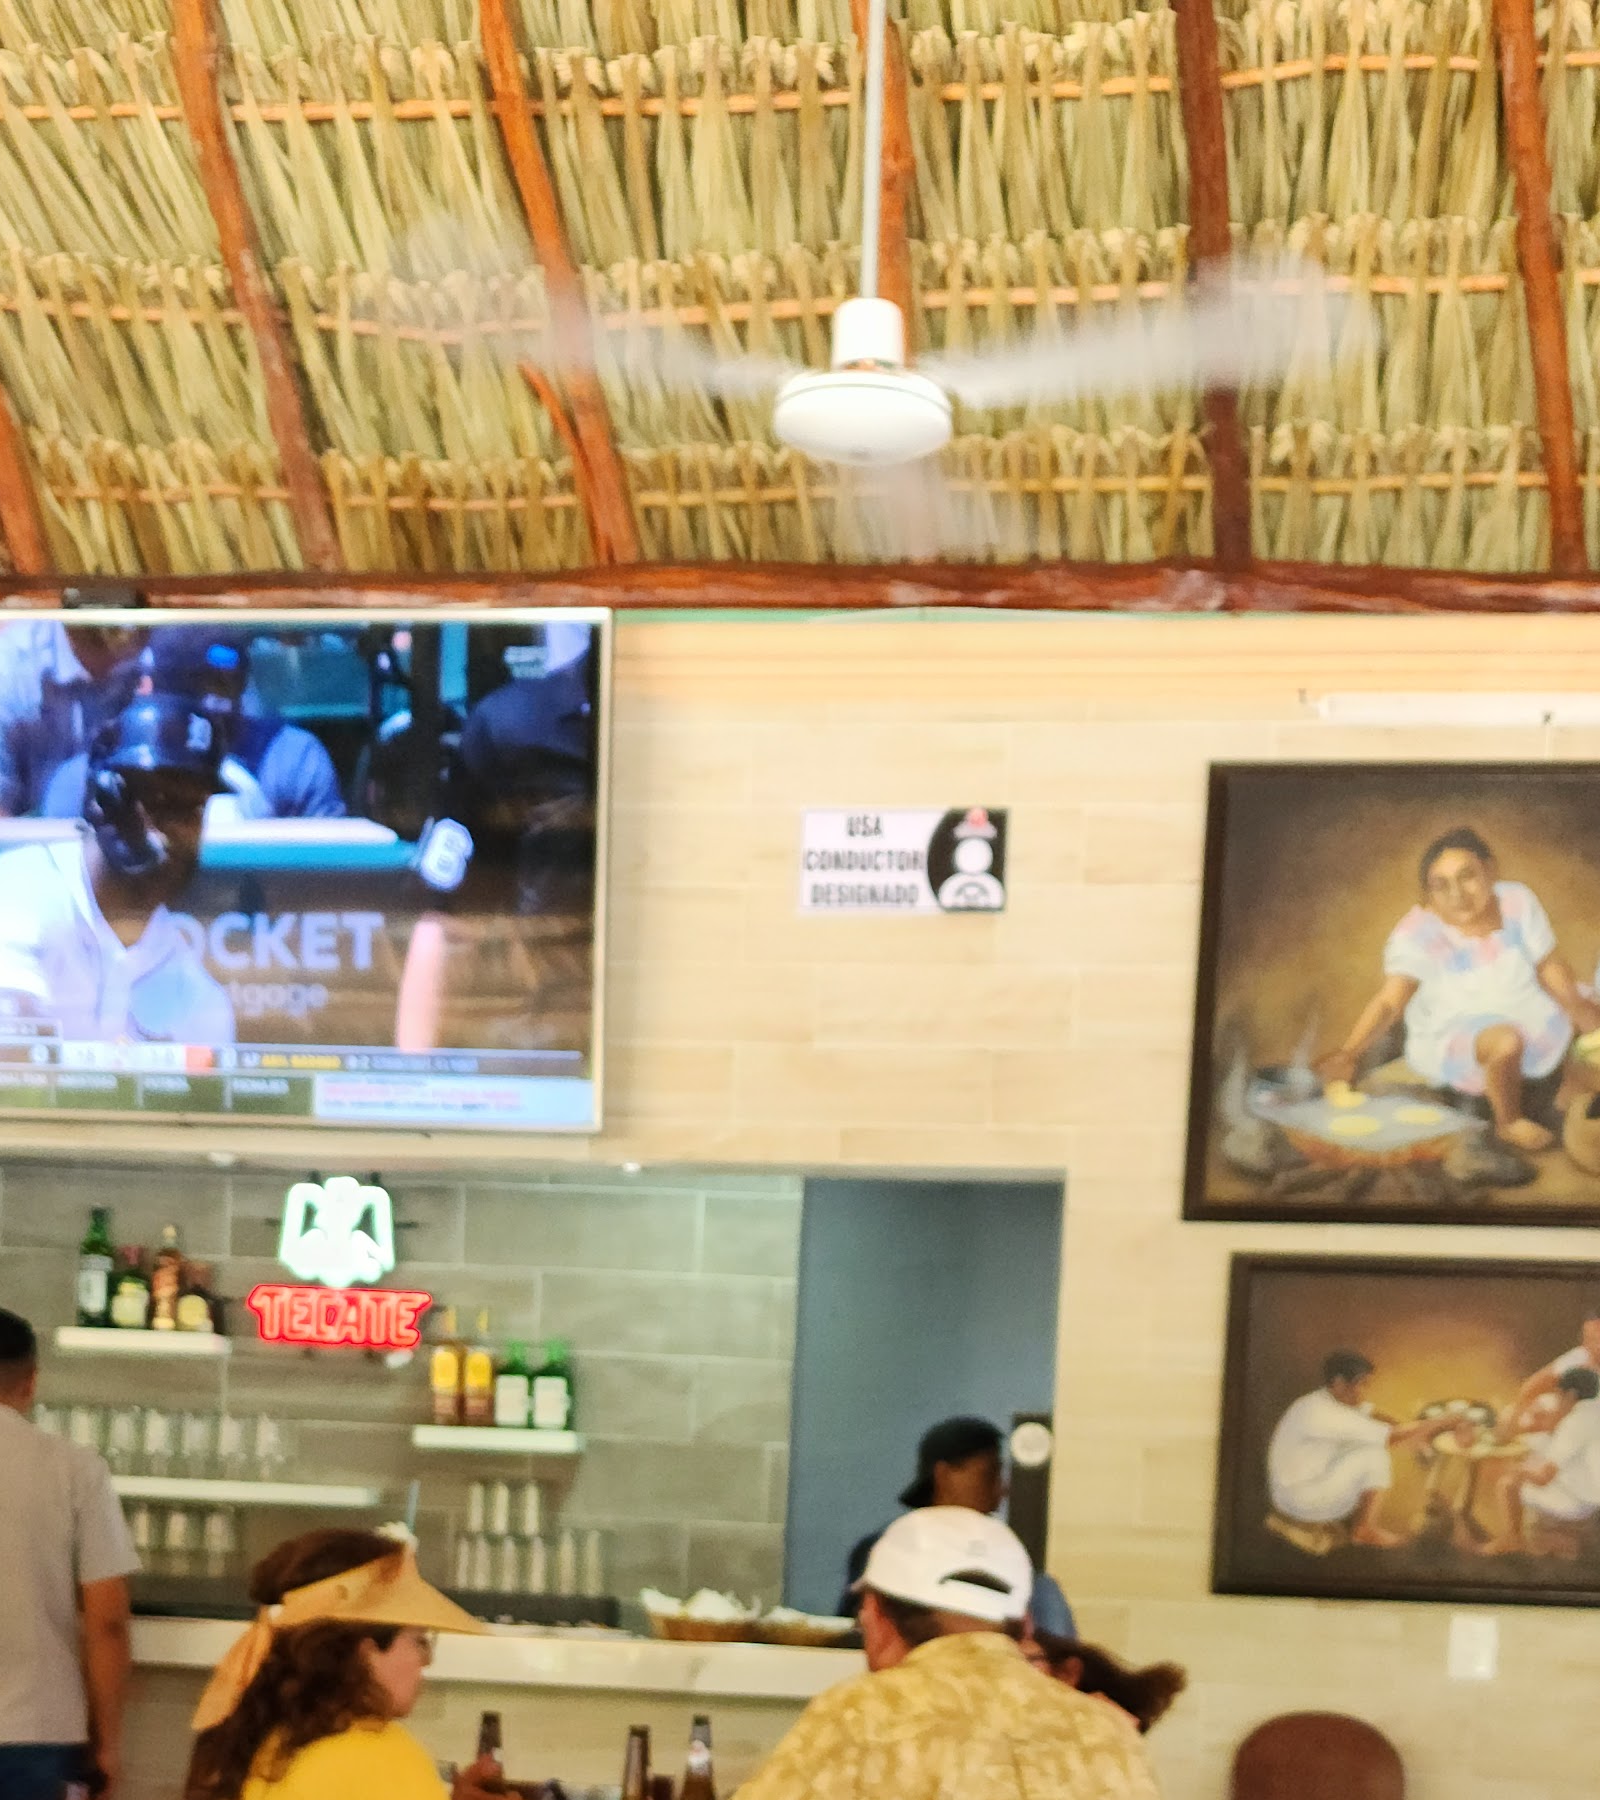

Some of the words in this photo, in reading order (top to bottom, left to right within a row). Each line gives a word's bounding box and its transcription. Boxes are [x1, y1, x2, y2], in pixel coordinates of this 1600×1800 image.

[846, 815, 883, 838] USA
[804, 849, 925, 873] CONDUCTOR
[810, 882, 919, 907] DESIGNADO
[248, 1284, 433, 1347] TECATE
